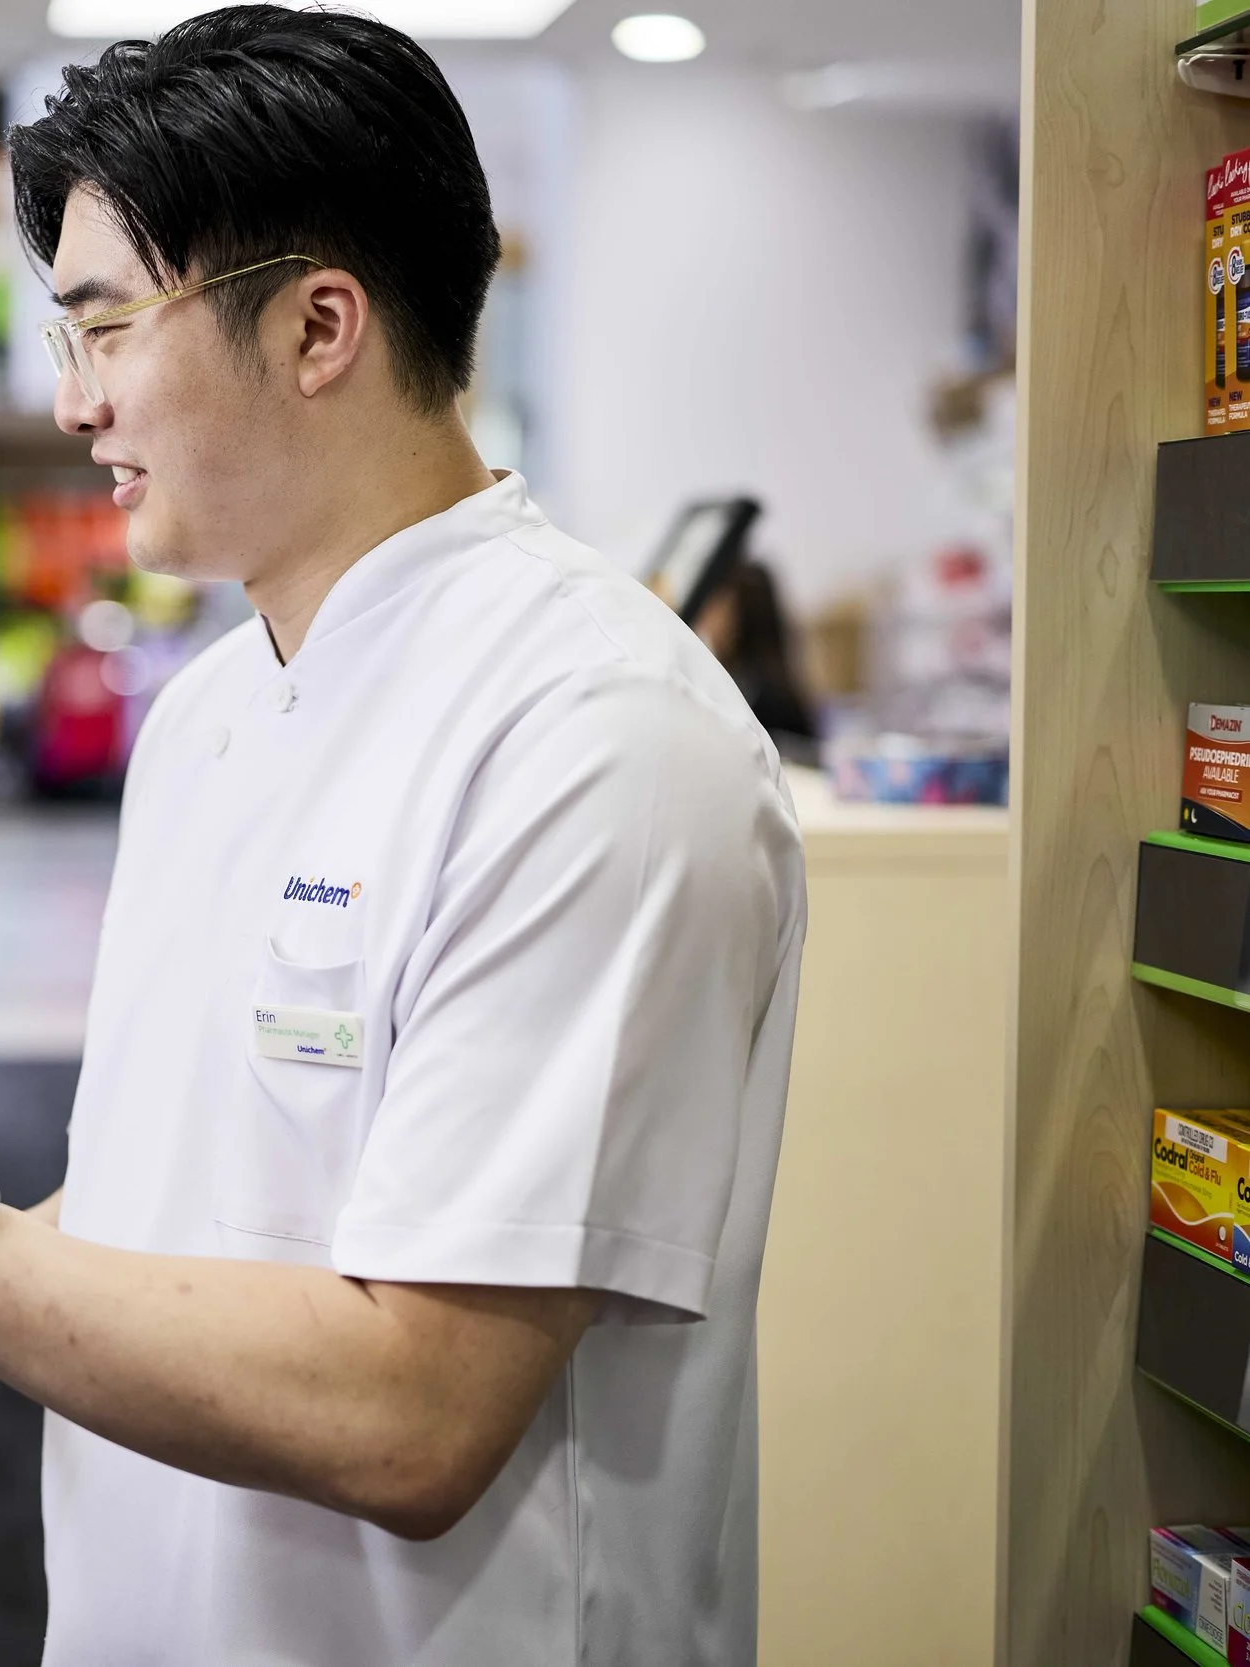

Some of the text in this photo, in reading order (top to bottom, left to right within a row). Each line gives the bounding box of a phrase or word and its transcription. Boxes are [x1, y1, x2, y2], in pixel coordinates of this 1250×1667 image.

[1229, 391, 1243, 402] NEW
[1202, 765, 1239, 783] AVAILABLE
[283, 876, 350, 908] Unichem
[255, 1010, 276, 1023] Erin
[297, 1045, 325, 1055] Unichem
[1154, 1138, 1189, 1170] Codral
[1188, 1162, 1204, 1178] Cold
[1211, 1170, 1222, 1185] Flu
[1234, 1252, 1248, 1266] Cold
